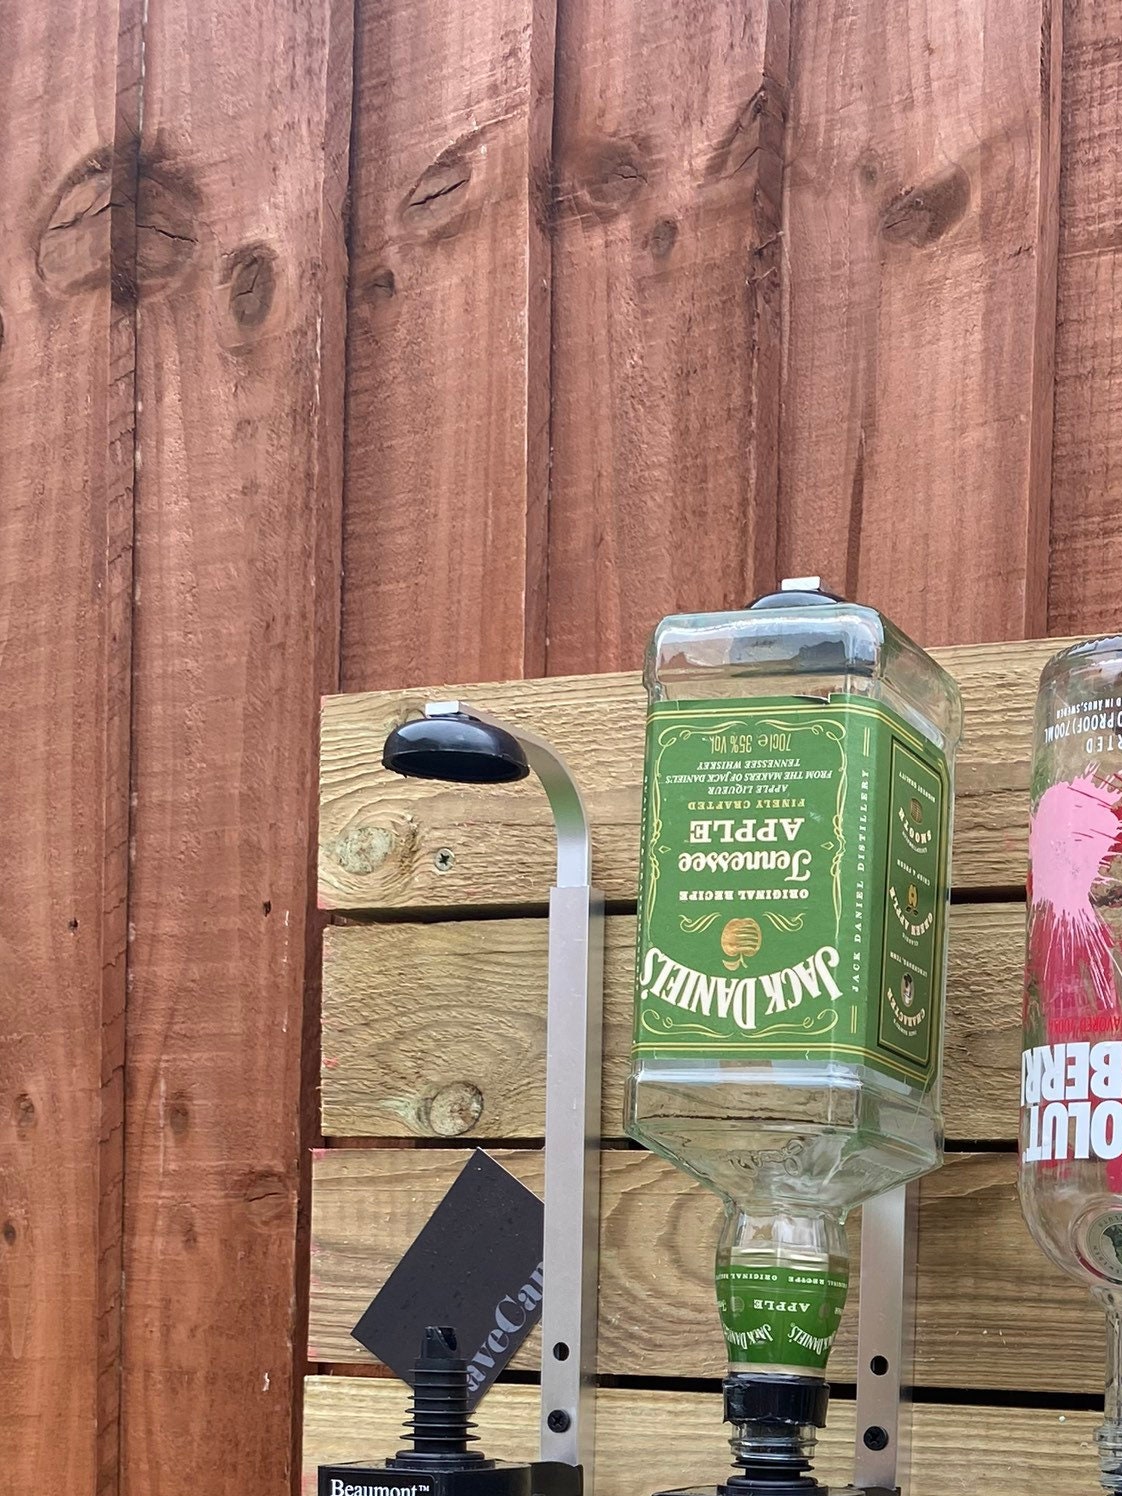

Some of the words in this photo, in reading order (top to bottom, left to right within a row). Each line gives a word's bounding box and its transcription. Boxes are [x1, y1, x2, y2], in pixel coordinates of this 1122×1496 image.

[1104, 698, 1114, 708] IN
[730, 734, 753, 753] 35%
[697, 760, 742, 770] WHISKEY
[744, 758, 801, 769] TENNESSEE
[665, 774, 706, 784] DANIEL'S
[707, 771, 732, 782] JACK
[730, 773, 742, 782] OF
[744, 772, 783, 781] MAKERS
[784, 771, 804, 780] THE
[804, 770, 833, 779] FROM
[707, 784, 753, 795] LIQUEUR
[755, 784, 789, 794] APPLE
[687, 800, 751, 810] CRAFTED
[755, 798, 805, 808] FINELY
[857, 769, 869, 871] DISTILLERY
[689, 818, 805, 843] APPLE
[678, 849, 812, 882] Tennessee
[679, 890, 733, 901] RECIPE
[738, 889, 809, 900] ORIGINAL
[854, 880, 864, 943] DANIEL
[851, 952, 860, 992] JACK
[759, 946, 843, 1015] JACK
[639, 947, 757, 1029] DANIEL'S
[730, 1273, 778, 1281] ORIGINAL
[788, 1276, 825, 1285] RECIPE
[753, 1299, 811, 1312] APPLE
